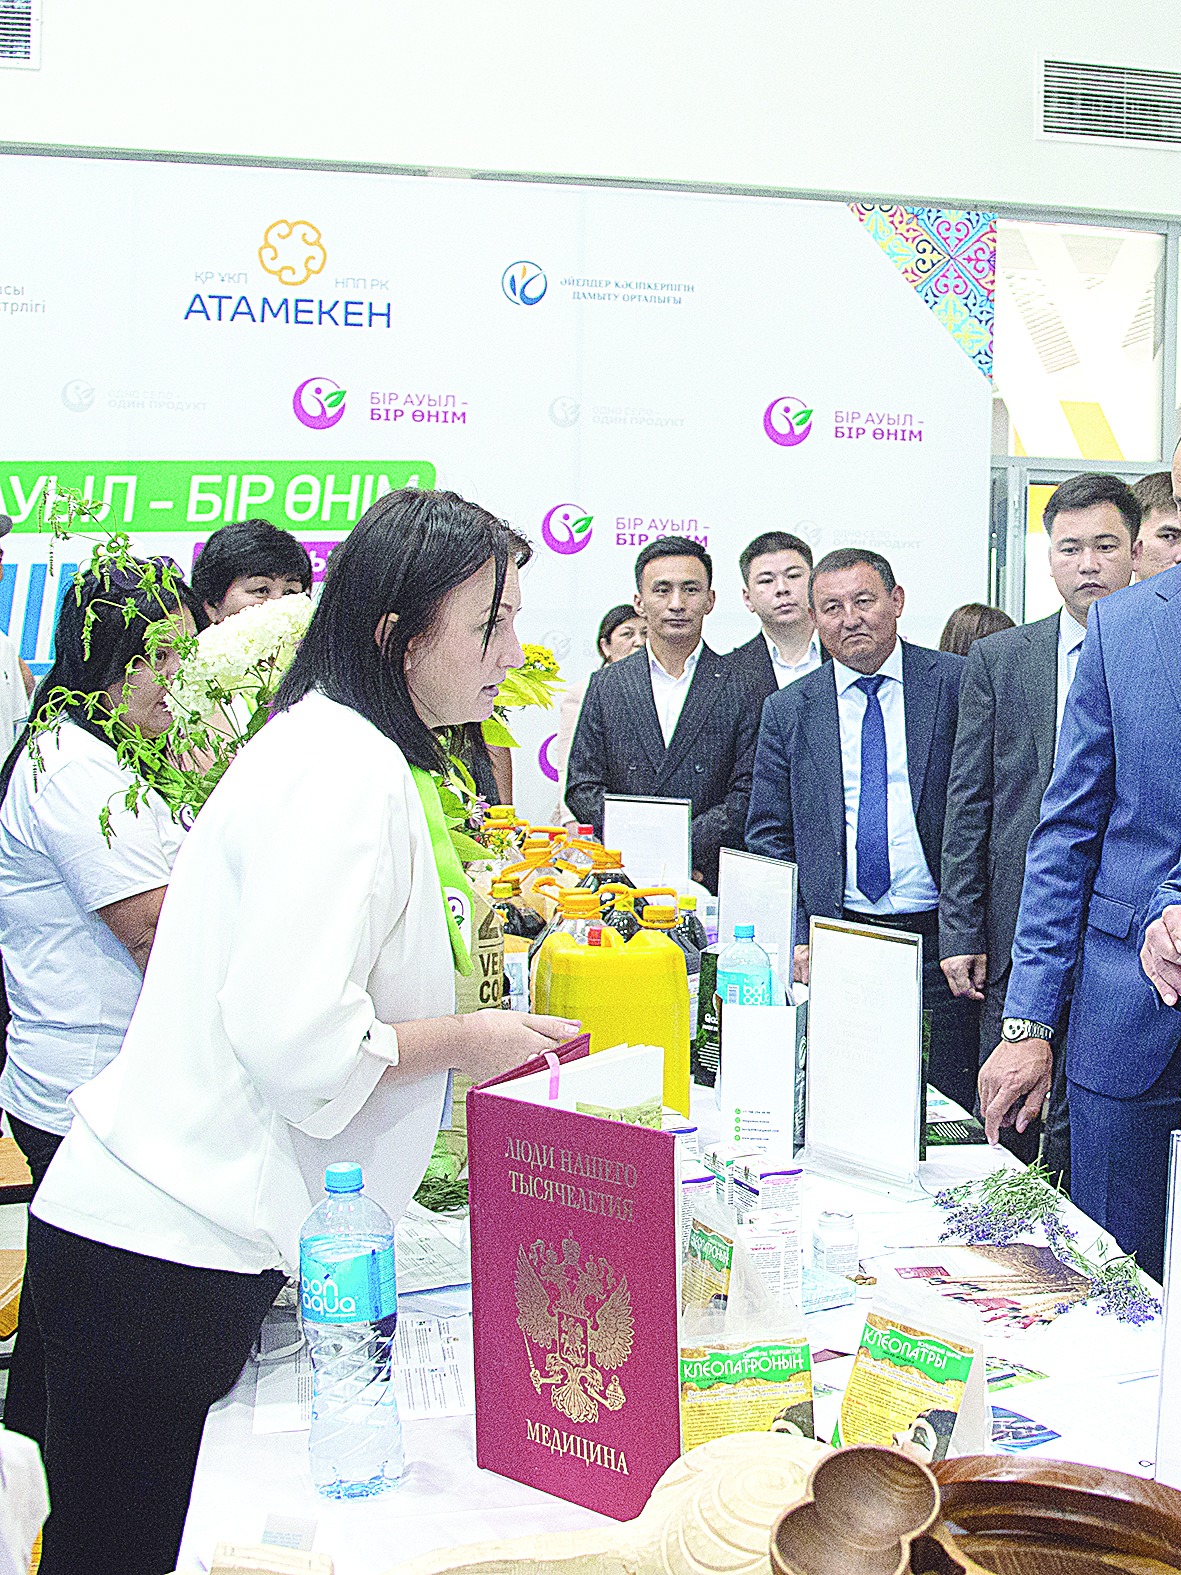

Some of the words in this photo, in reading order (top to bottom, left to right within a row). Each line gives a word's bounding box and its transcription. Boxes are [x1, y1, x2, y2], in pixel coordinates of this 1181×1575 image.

[0, 285, 24, 296] сы
[334, 277, 367, 290] НПП
[370, 278, 389, 291] РК
[0, 300, 45, 315] трлігі
[184, 293, 391, 328] АТАМЕКЕН
[370, 391, 400, 407] БІР
[402, 392, 457, 408] АУЫЛ
[370, 408, 405, 423] БІР
[412, 409, 467, 425] ӨНІМ
[834, 411, 861, 426] БІР
[864, 411, 913, 427] АУЫЛ
[834, 427, 866, 441] БІР
[873, 428, 923, 442] ӨНІМ
[186, 474, 275, 523] БІР
[616, 517, 643, 530] БІР
[647, 518, 698, 532] АУЫЛ
[616, 533, 649, 546] БІР
[505, 1137, 555, 1171] ЛЮДИ
[560, 1150, 637, 1189] НАШЕГО
[508, 1171, 634, 1222] ТЫСЯЧЕЛЕТИЯ
[301, 1273, 339, 1296] bon
[302, 1292, 356, 1316] aqua
[863, 1327, 948, 1370] КЛЕОПАТРЫ
[526, 1418, 630, 1475] МЕДИЦИНА
